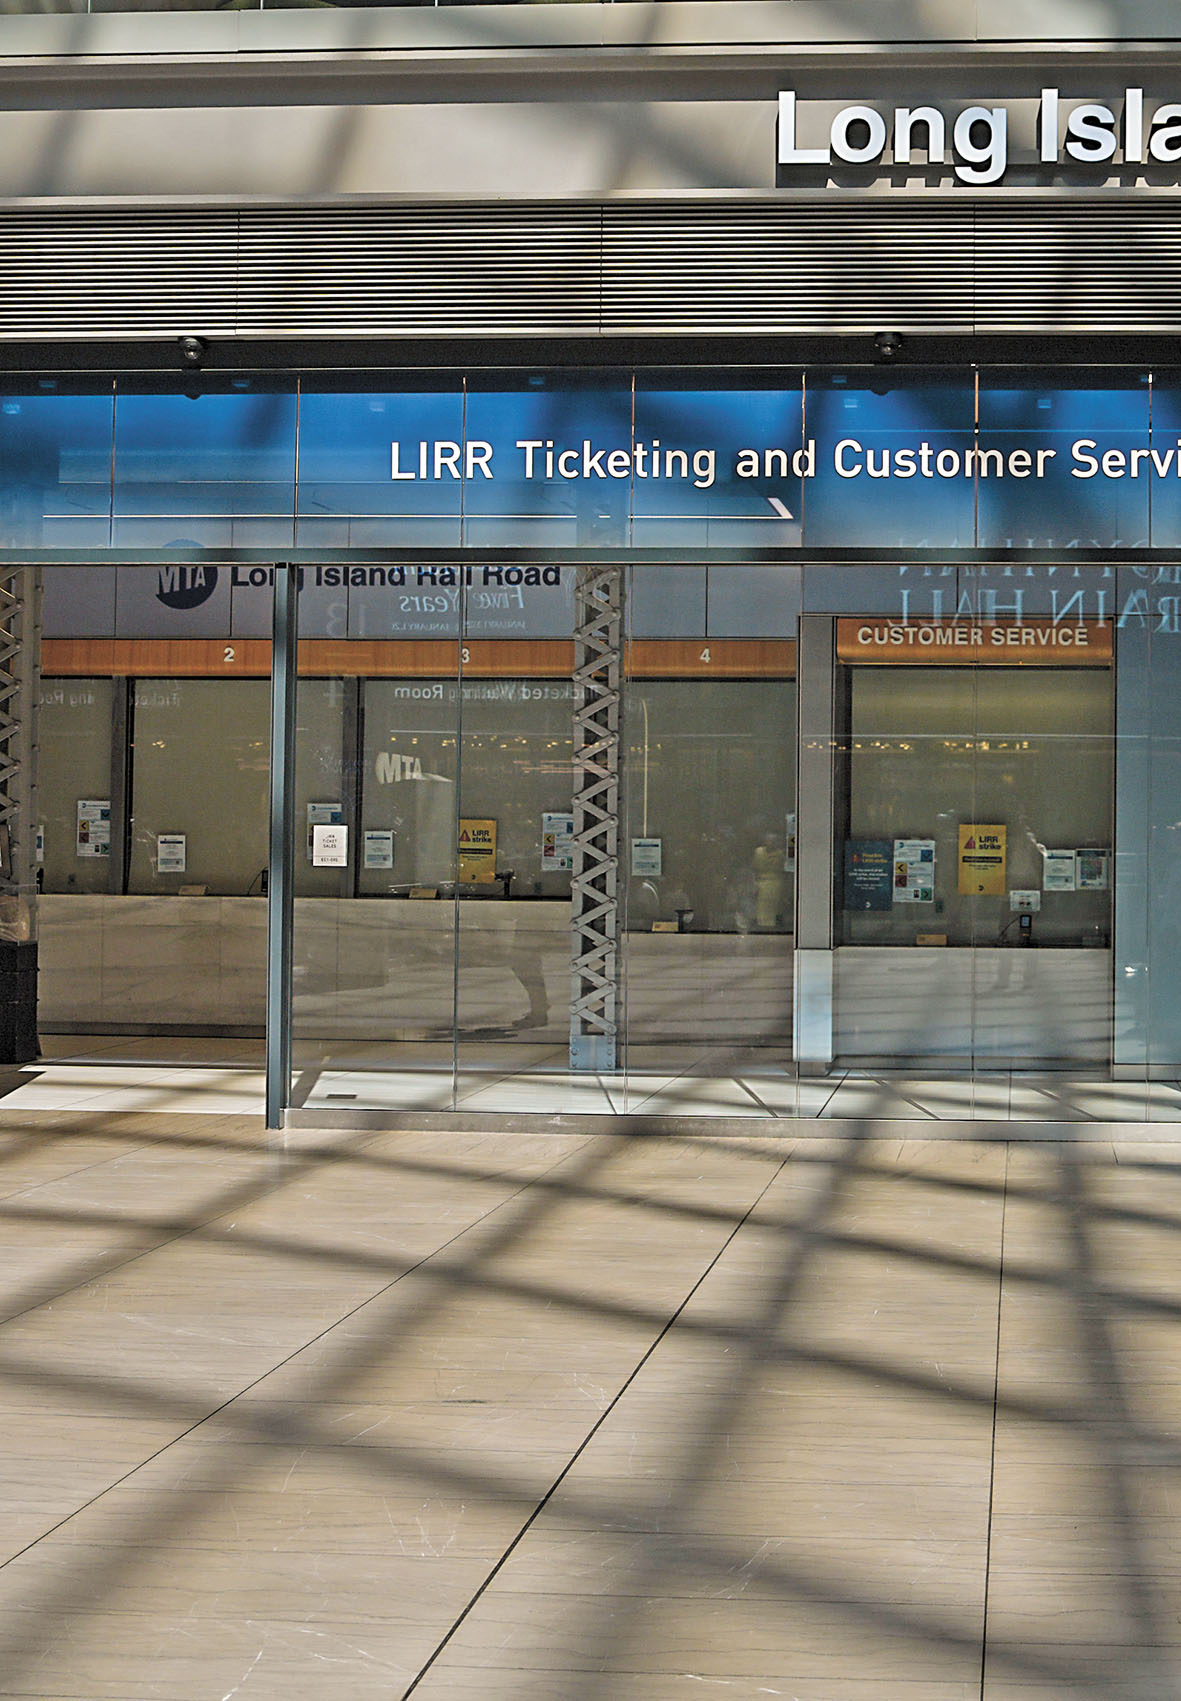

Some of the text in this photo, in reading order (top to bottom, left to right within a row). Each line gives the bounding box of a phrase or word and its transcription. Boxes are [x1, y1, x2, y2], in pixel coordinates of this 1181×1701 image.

[777, 89, 1008, 184] Long
[391, 440, 494, 480] LIRR
[515, 439, 716, 488] Ticketing
[736, 438, 816, 479] and
[833, 438, 1057, 479] Customer
[231, 566, 304, 593] Lo
[483, 566, 561, 587] Road
[857, 625, 1089, 646] CUSTOMER SERVICE
[222, 646, 235, 664] 2
[699, 647, 712, 665] 4
[376, 752, 423, 785] MTA
[471, 829, 490, 837] LIRR
[978, 835, 999, 844] LIRR
[978, 843, 1002, 851] strike
